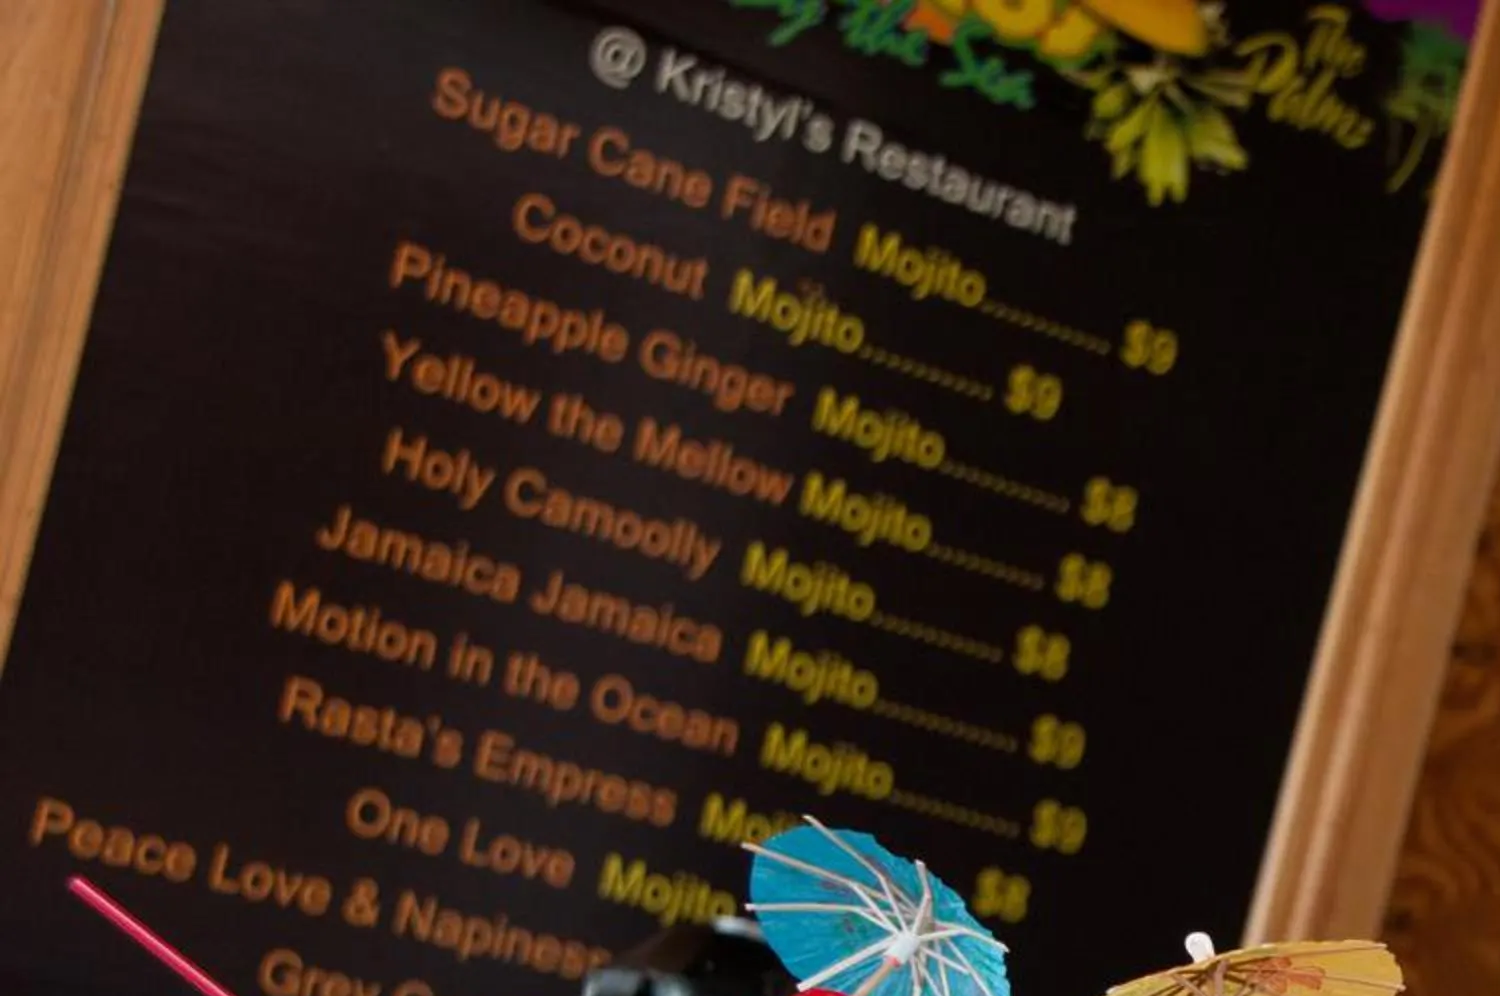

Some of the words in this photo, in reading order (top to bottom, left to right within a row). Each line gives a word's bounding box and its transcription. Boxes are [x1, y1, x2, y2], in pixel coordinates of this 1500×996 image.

[431, 66, 580, 159] Sugar
[588, 126, 713, 208] Cane
[719, 173, 836, 254] Field
[852, 221, 987, 308] Mojito
[654, 50, 834, 153] Kristyl's
[840, 121, 1078, 245] Restaurant
[389, 240, 629, 363] Pineapple
[639, 328, 796, 416] Ginger
[811, 384, 946, 470] Mojito
[512, 191, 709, 299] Coconut
[730, 268, 865, 352] Mojito
[380, 328, 543, 423] Yellow
[547, 390, 623, 452] the
[634, 417, 792, 502] Mellow
[799, 470, 933, 552] Mojito
[381, 427, 496, 511] Holy
[504, 466, 725, 581] Camoolly
[739, 542, 876, 622] Mojito
[270, 579, 438, 670] Motion
[447, 631, 495, 686] in
[504, 650, 581, 711] the
[591, 673, 741, 757] Ocean
[760, 721, 895, 799] Mojito
[316, 503, 521, 603] Jamaica
[529, 569, 723, 663] Jamaica
[742, 628, 879, 710] Mojito
[278, 673, 464, 770] Rasta's
[473, 729, 677, 827] Empress
[27, 796, 197, 882] Peace
[208, 842, 334, 916] Love
[341, 877, 381, 928] &
[344, 786, 451, 857] One
[458, 816, 576, 888] Love
[598, 851, 737, 927] Mojito
